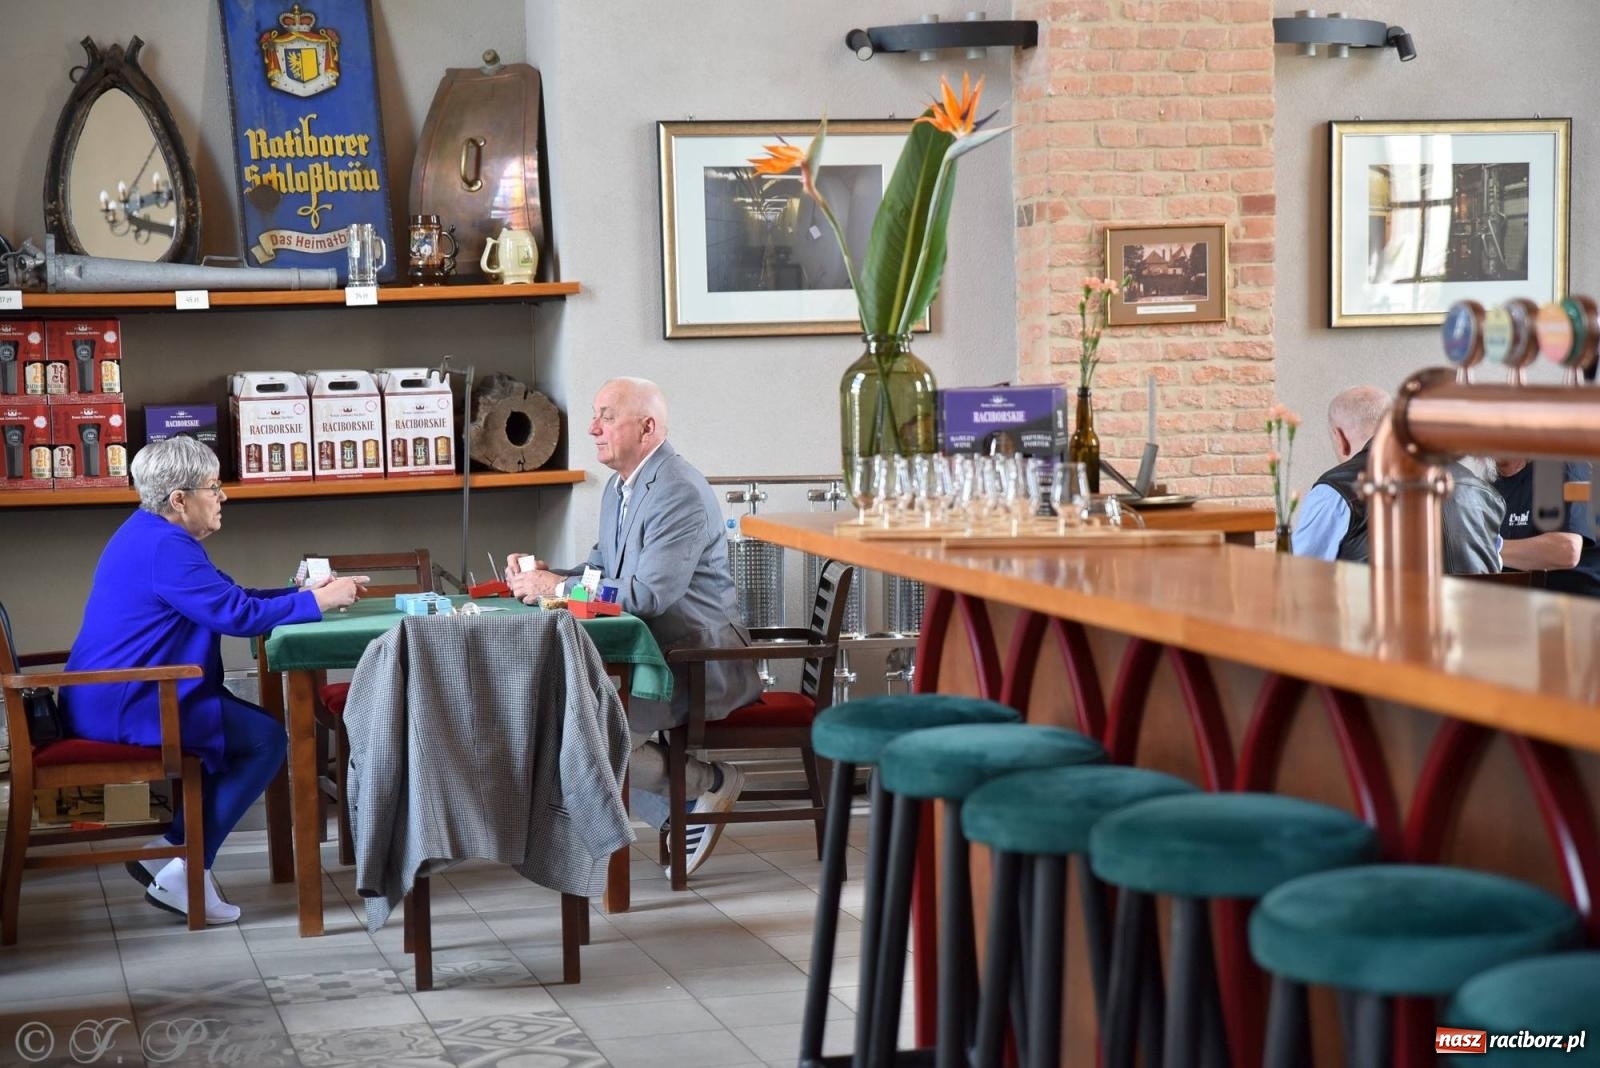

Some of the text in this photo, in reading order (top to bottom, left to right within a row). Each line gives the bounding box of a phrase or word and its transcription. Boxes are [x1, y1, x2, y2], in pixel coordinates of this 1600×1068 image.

[269, 231, 348, 250] Das Heimatb
[249, 423, 304, 435] RACIBORSKIE
[322, 420, 375, 432] RACIBORSKIE
[395, 418, 447, 430] RACIBORSKIE
